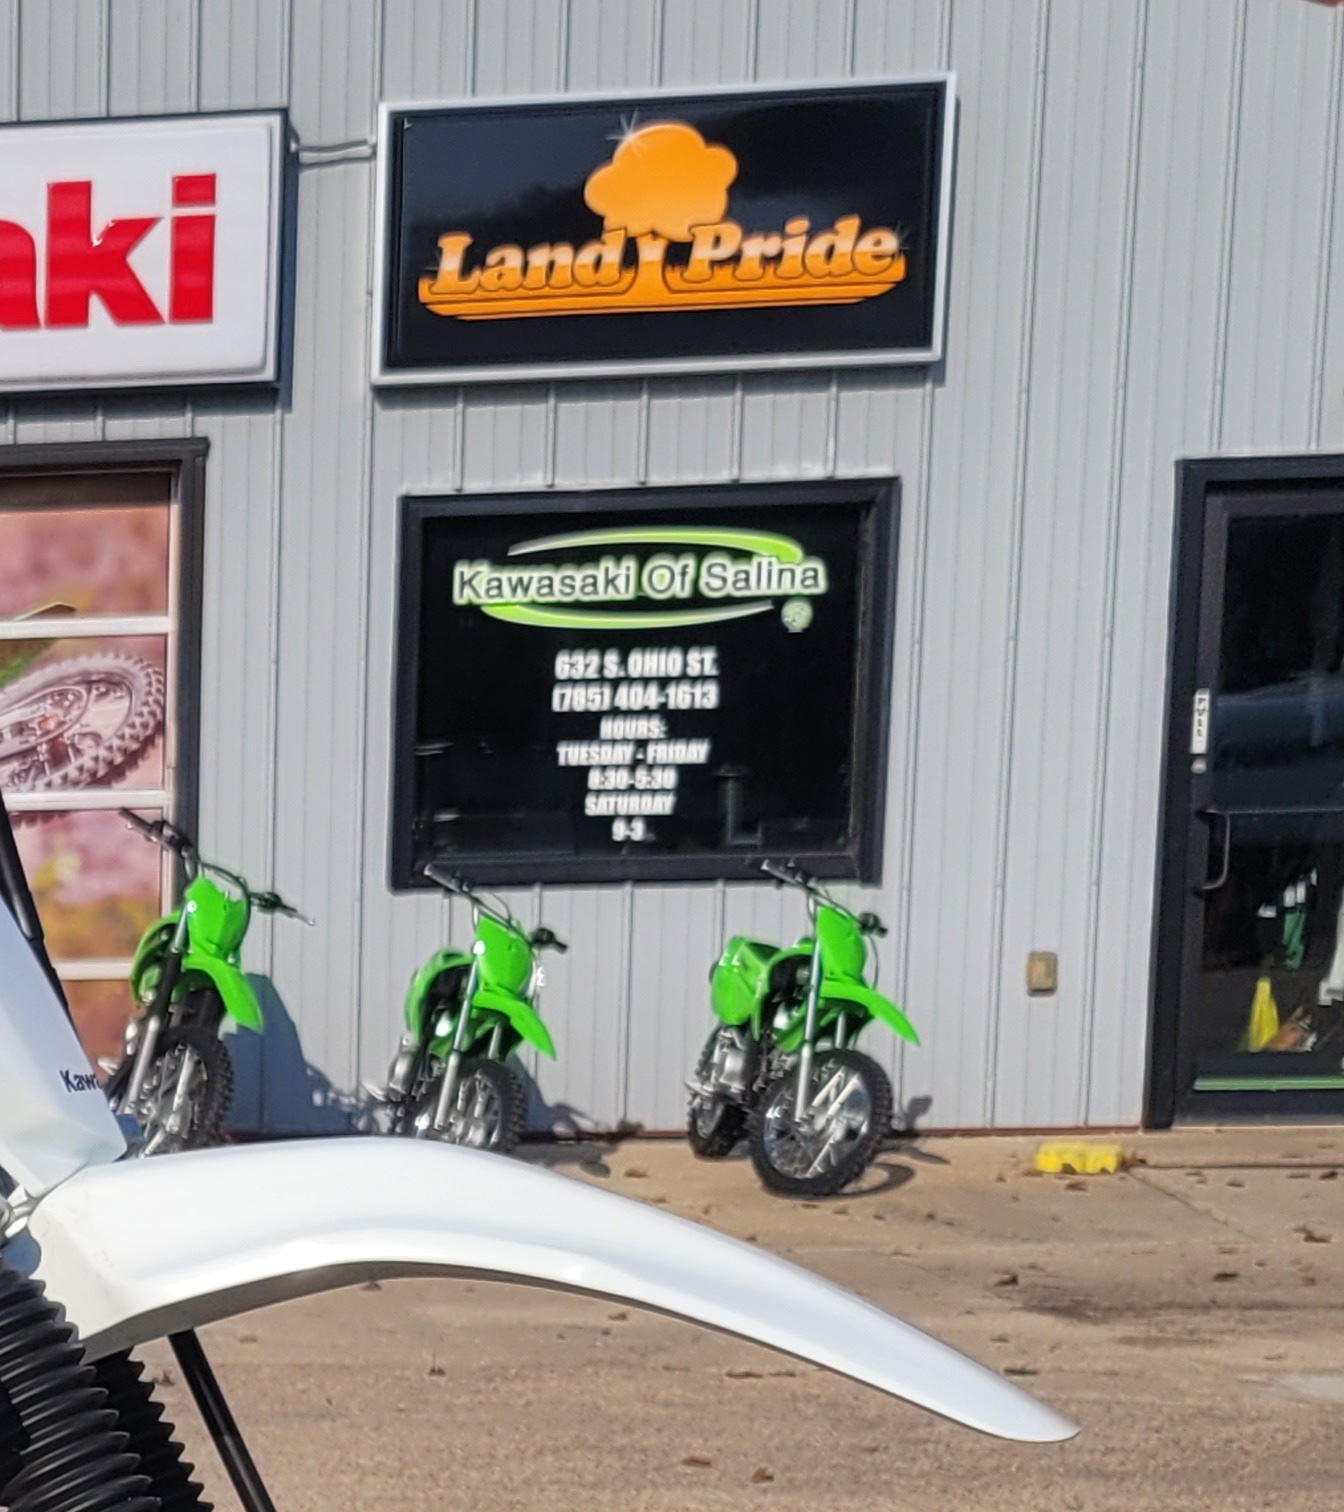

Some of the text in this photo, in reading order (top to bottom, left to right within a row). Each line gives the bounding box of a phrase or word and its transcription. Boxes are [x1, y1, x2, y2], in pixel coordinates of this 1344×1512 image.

[429, 214, 901, 295] Land Pride
[455, 557, 823, 602] Kawasaki Of Salina
[555, 646, 719, 680] 632 S. OHIO ST.
[552, 679, 720, 712] (785) 404-1613
[557, 740, 635, 766] TUESDAY
[646, 738, 711, 764] FRIDAY
[585, 791, 676, 816] SATURDAY
